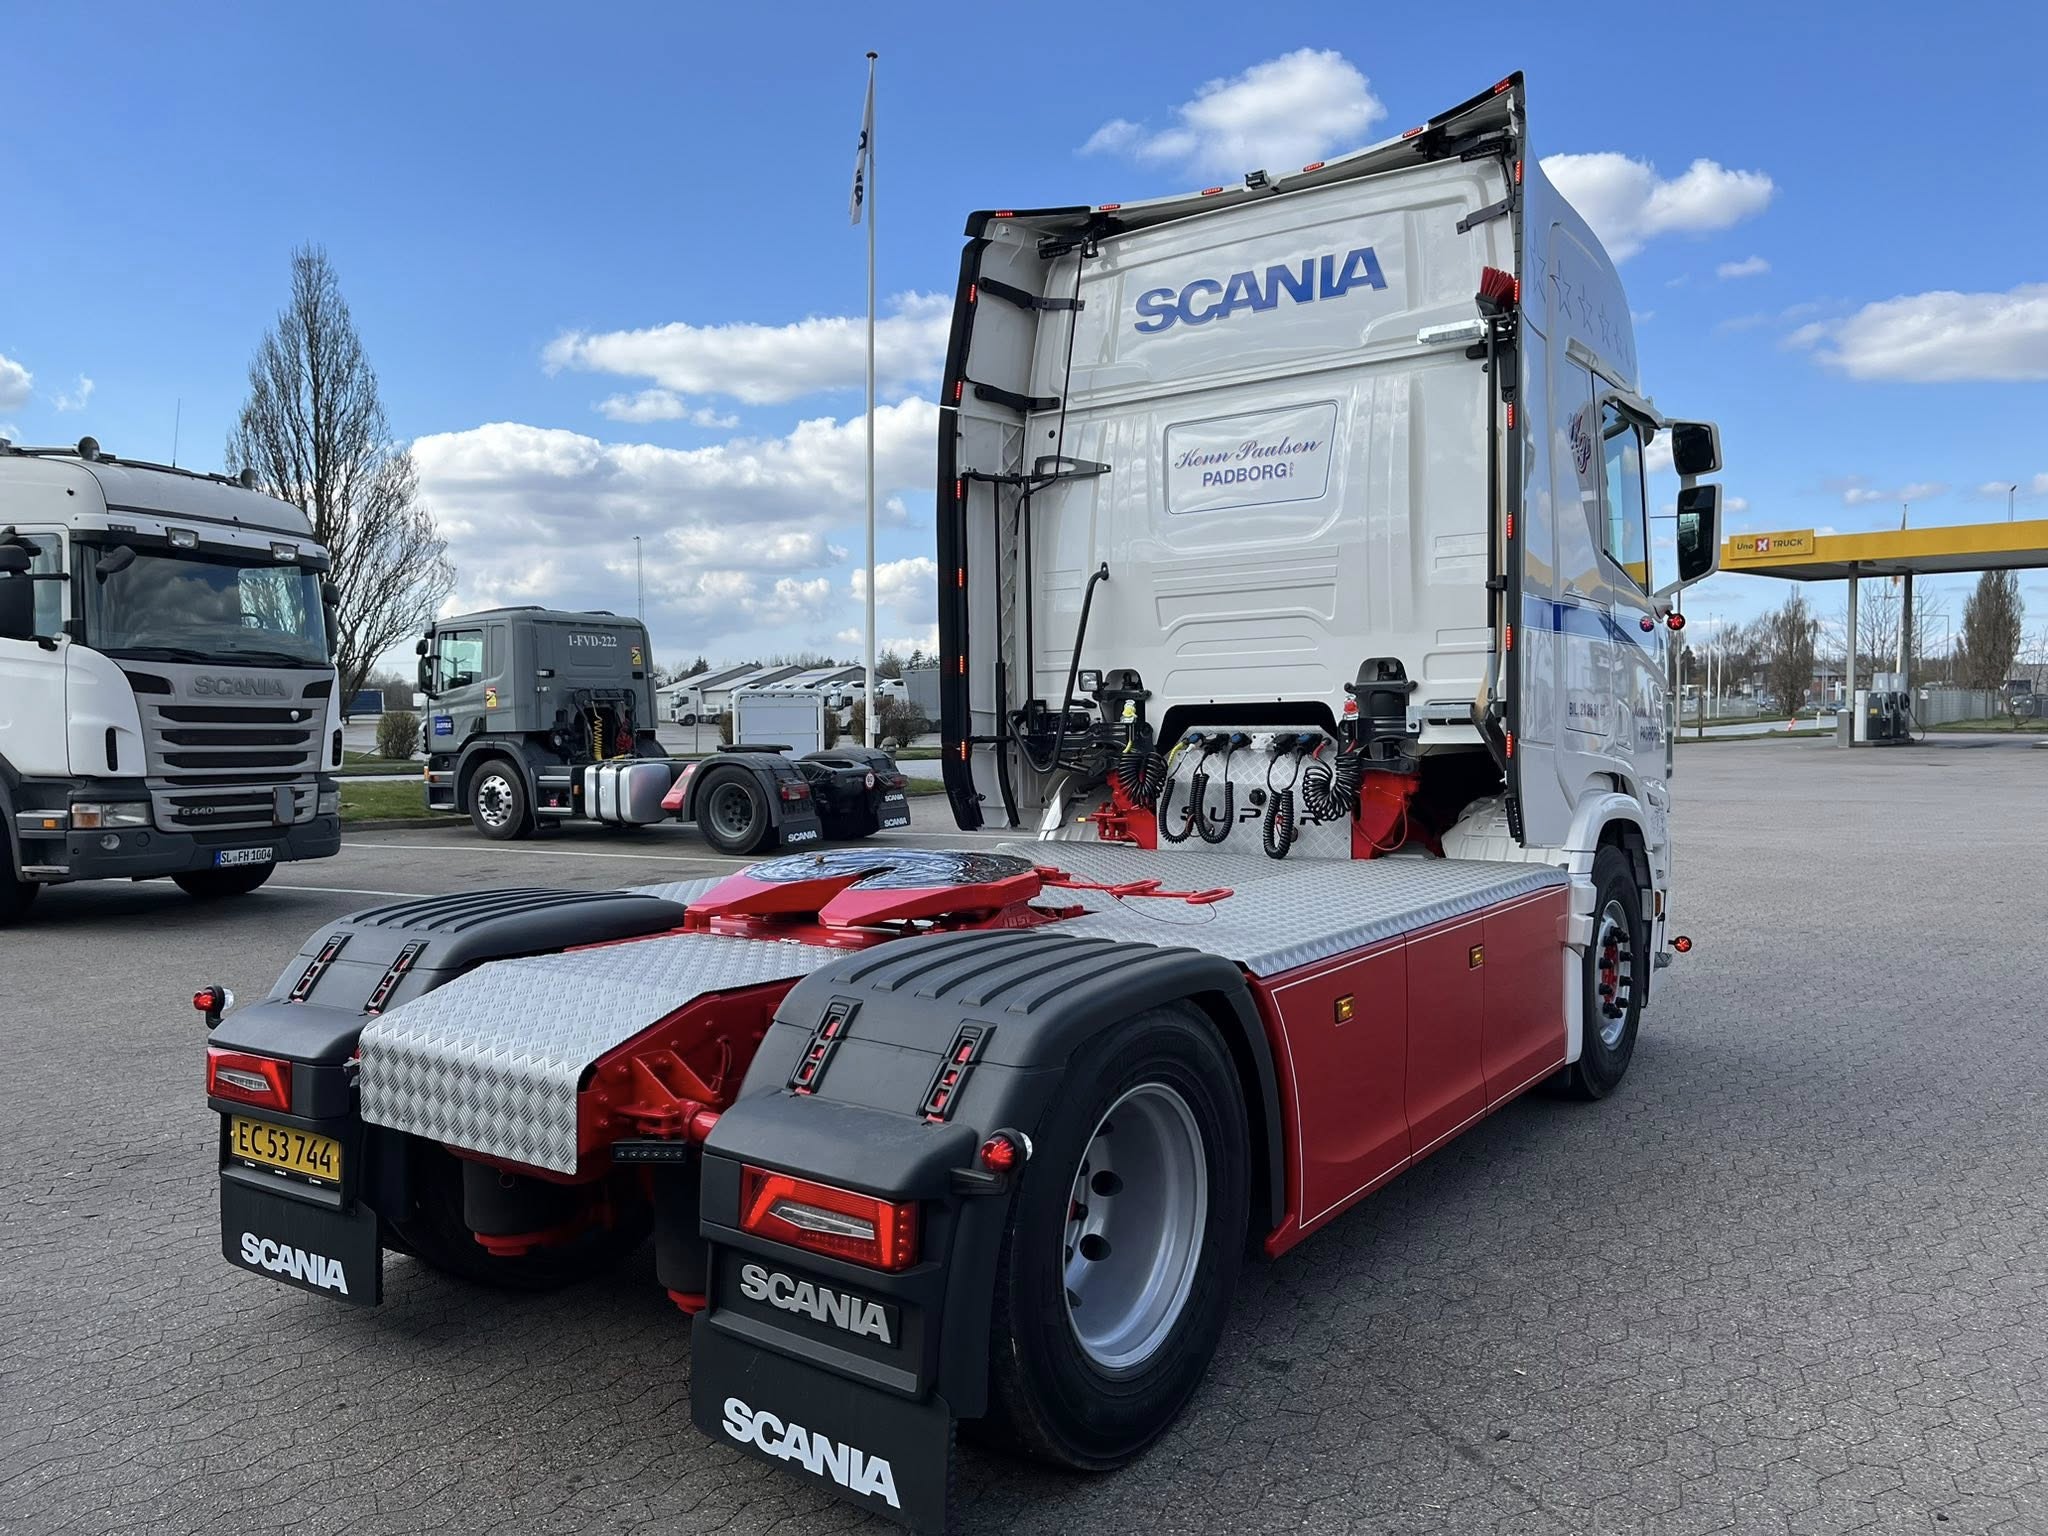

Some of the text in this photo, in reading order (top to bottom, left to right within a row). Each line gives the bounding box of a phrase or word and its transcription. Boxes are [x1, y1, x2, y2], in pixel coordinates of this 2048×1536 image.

[1134, 246, 1388, 334] SCANIA
[1235, 436, 1324, 461] Paulsen
[1202, 462, 1288, 488] PADBORG
[1736, 542, 1754, 551] Uno
[1773, 538, 1804, 548] TRUCK
[568, 634, 617, 647] 1-FVD-222
[194, 675, 287, 697] SCANIA
[884, 793, 905, 802] SCANIA
[191, 806, 214, 815] 440
[1180, 806, 1322, 826] SUPR
[884, 817, 908, 828] SCANIA
[788, 830, 818, 842] SCANIA
[239, 1122, 331, 1174] EC 53 744
[240, 1231, 348, 1295] SCANIA
[740, 1264, 892, 1344] SCANIA
[722, 1397, 901, 1509] SCANIA
